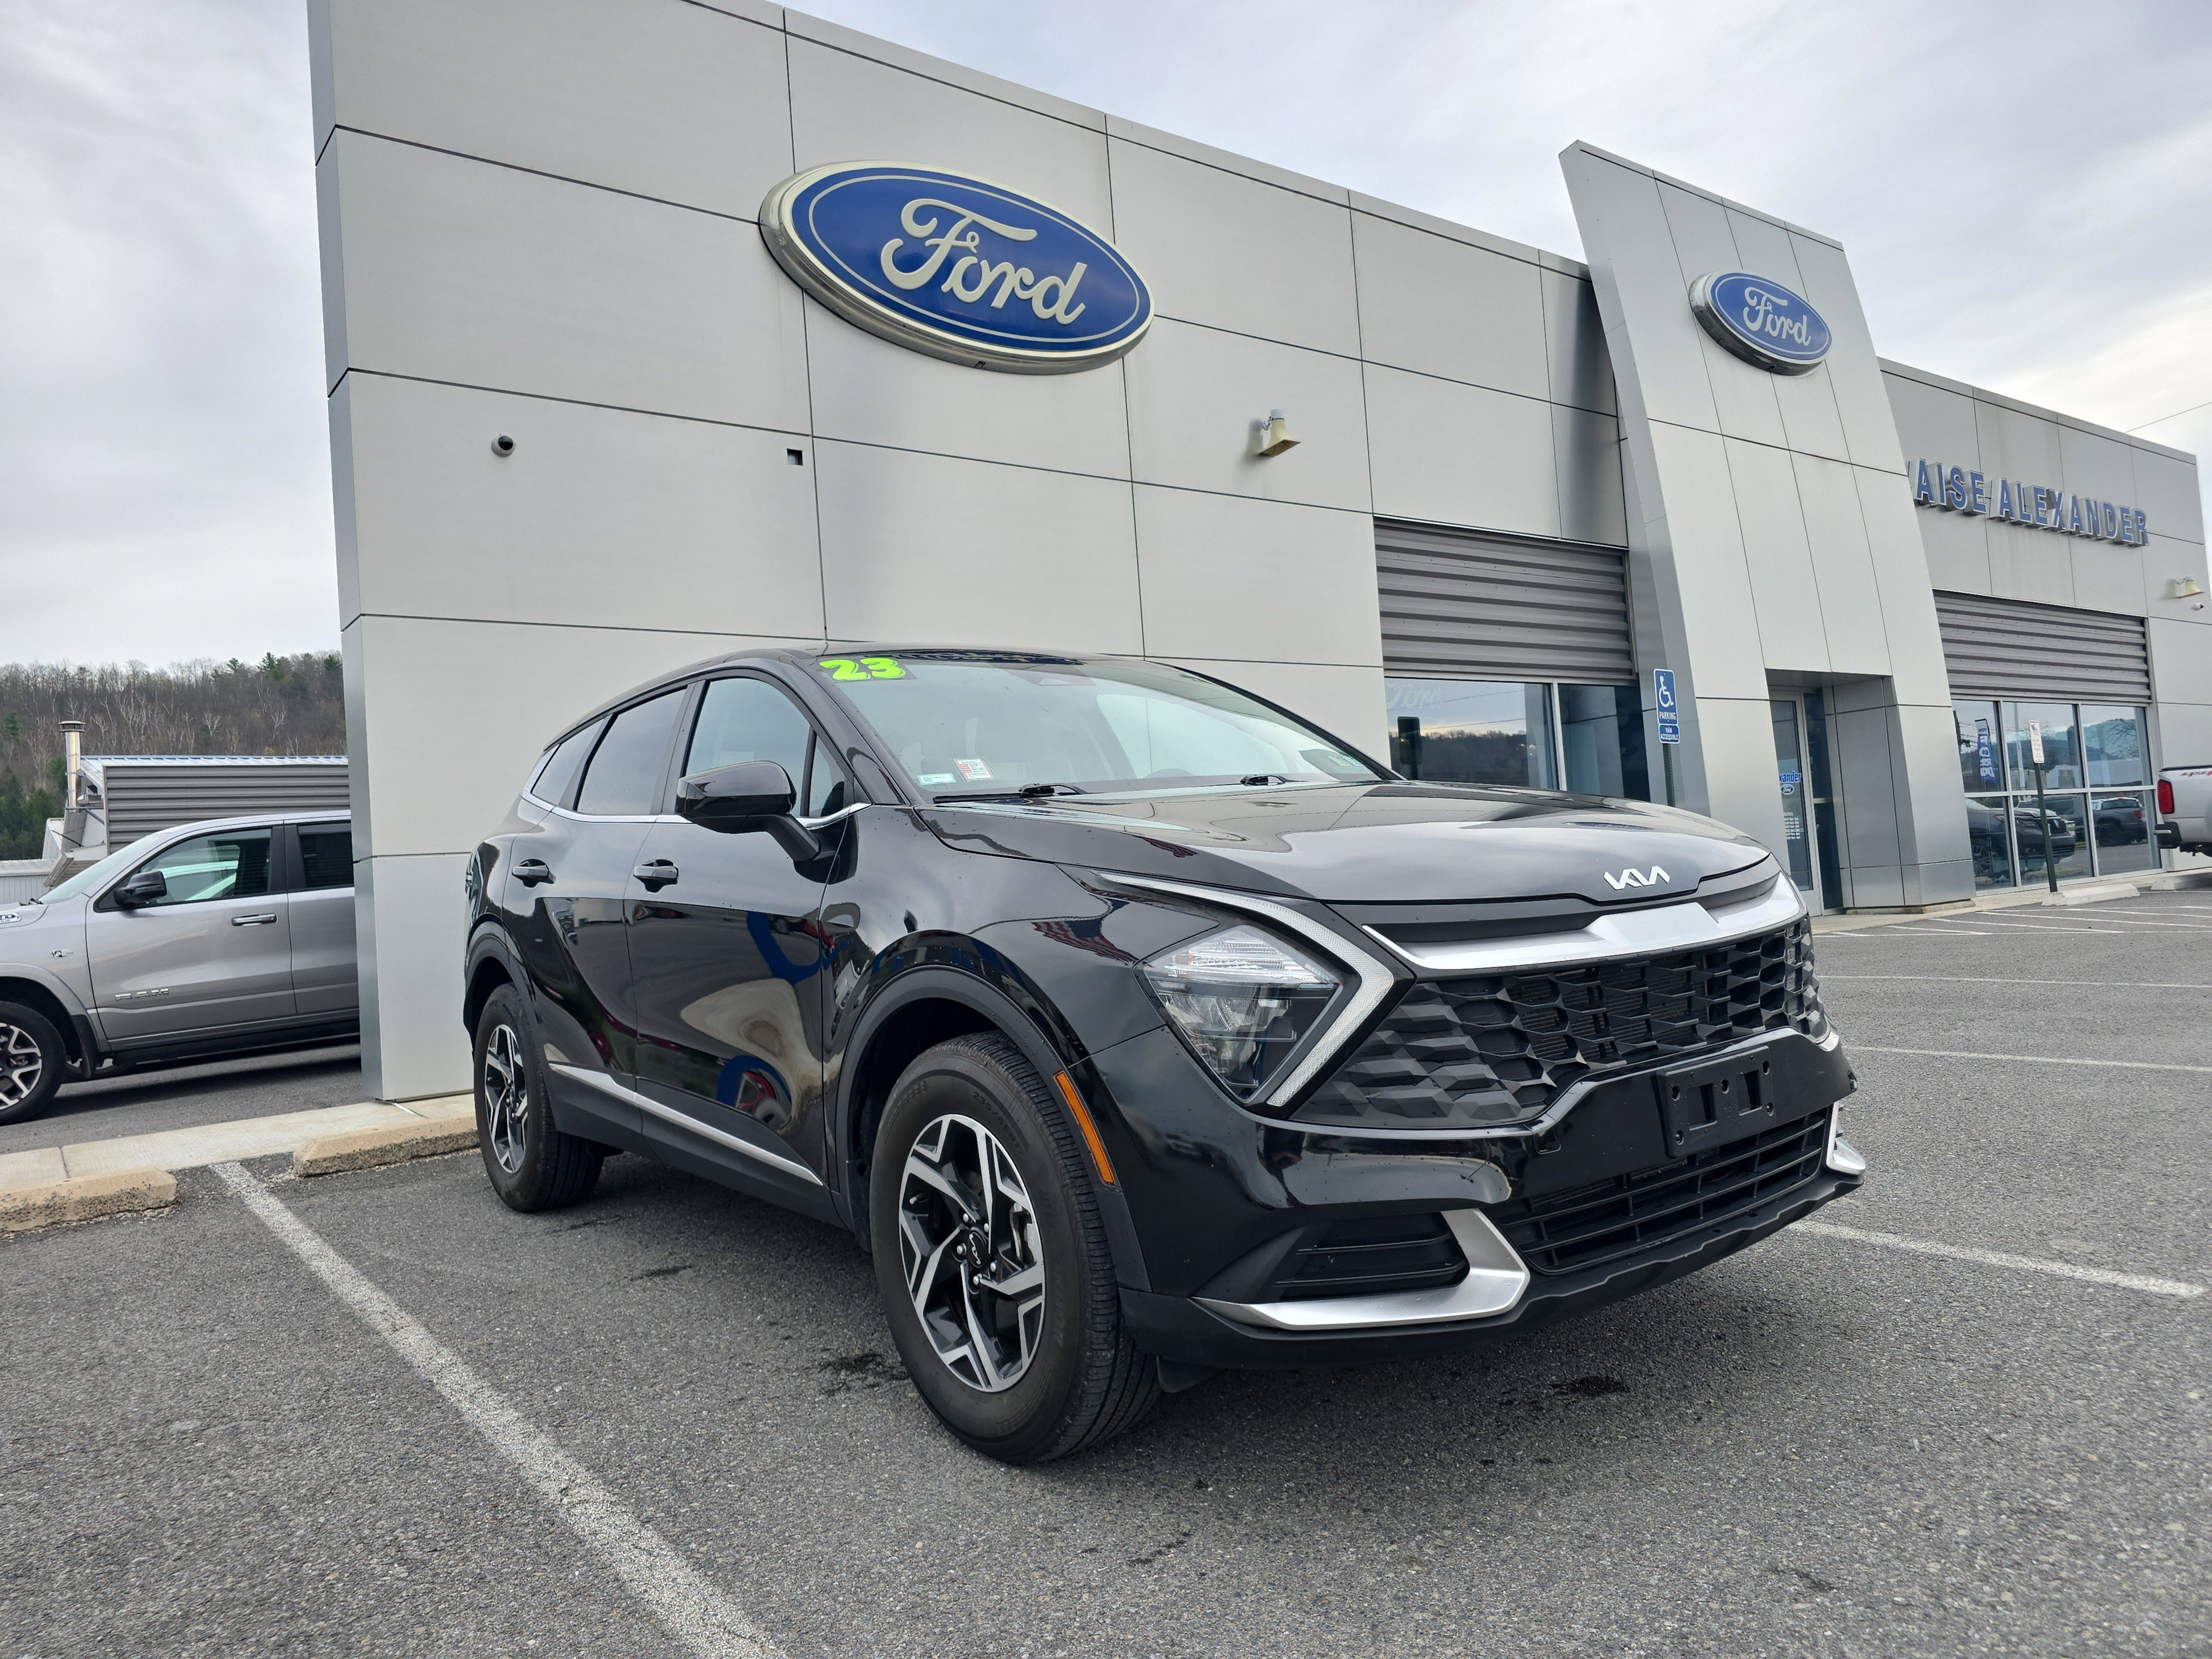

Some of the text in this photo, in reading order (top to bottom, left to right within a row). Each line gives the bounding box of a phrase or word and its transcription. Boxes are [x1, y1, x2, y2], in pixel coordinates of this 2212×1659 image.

[881, 198, 1088, 325] Ford
[1742, 287, 1811, 346] Ford
[1915, 458, 2150, 546] AISE ALEXANDER
[820, 658, 906, 680] 23
[1659, 711, 1676, 720] PARKING
[1604, 866, 1670, 890] KIA
[115, 988, 169, 1001] RAM
[973, 1091, 1025, 1156] 235/65R17
